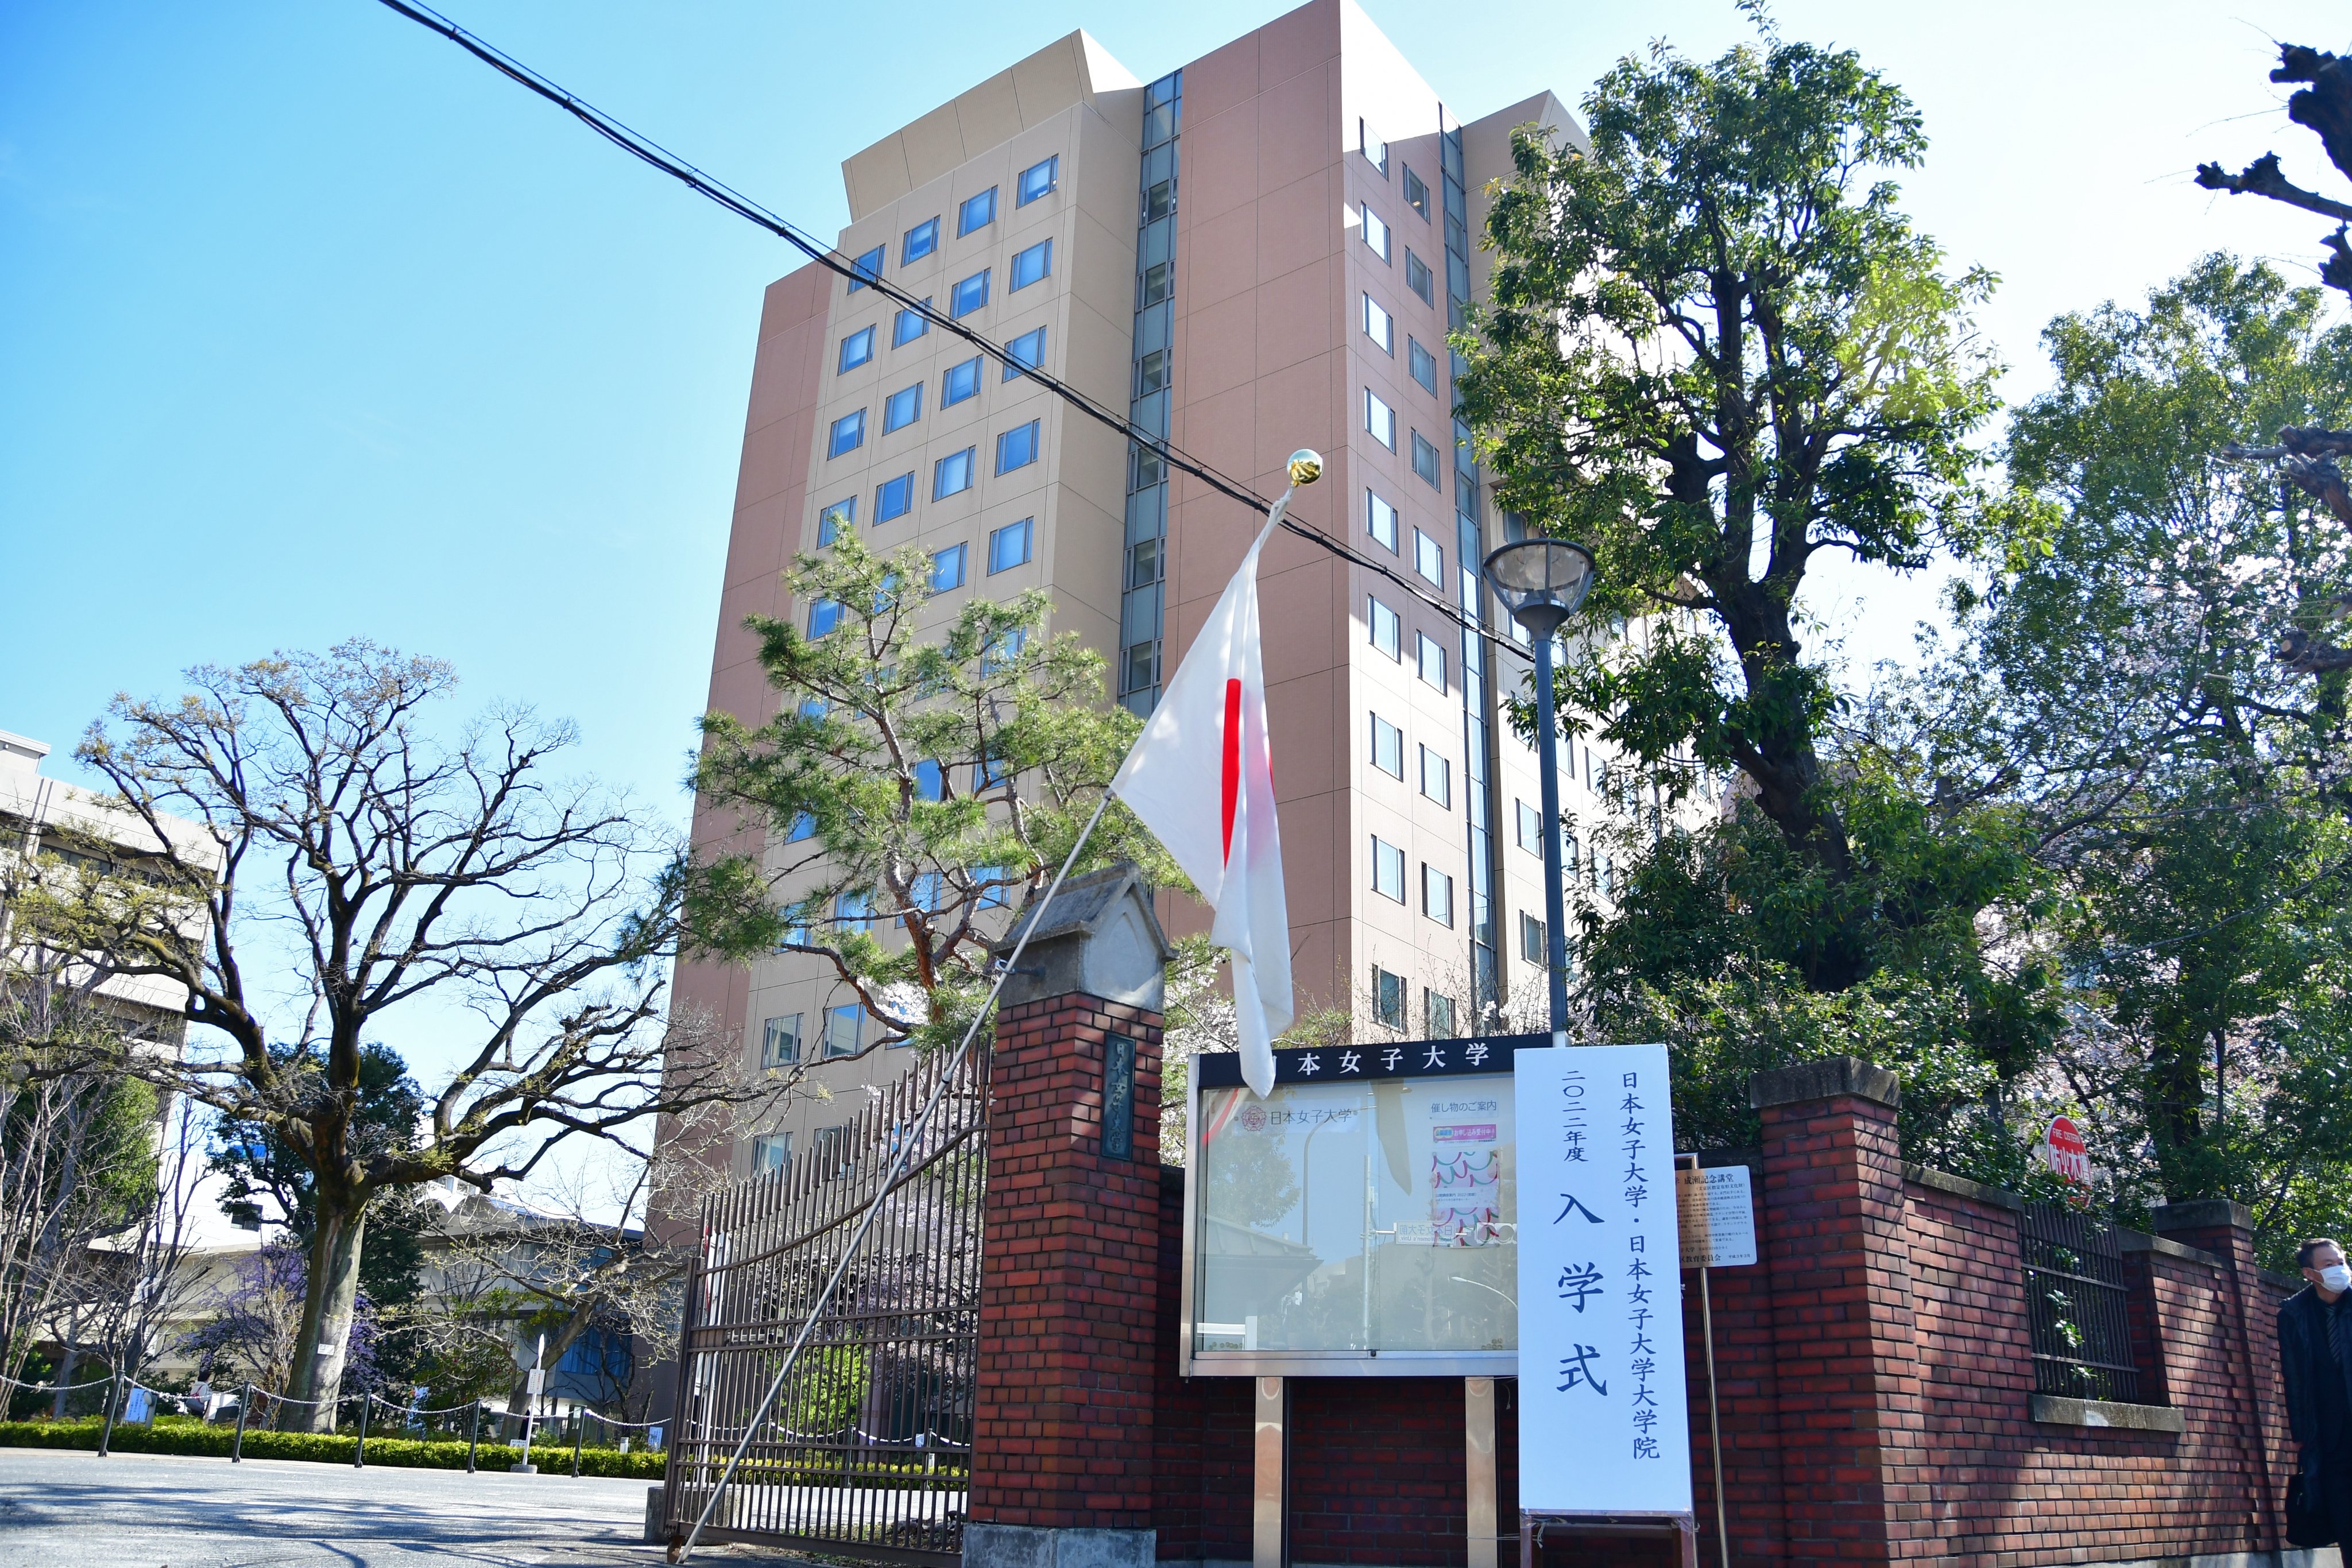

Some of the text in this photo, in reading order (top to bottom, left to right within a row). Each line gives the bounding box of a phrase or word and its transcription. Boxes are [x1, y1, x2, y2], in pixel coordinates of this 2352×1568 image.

[1272, 1043, 1489, 1075] 本女子大学
[1271, 1108, 1352, 1125] 日本女子大学
[1431, 1101, 1497, 1113] 催し物のご案内
[2052, 1128, 2063, 1139] FIRE
[1553, 1070, 1608, 1396] 二〇二二年度 入学式
[1619, 1072, 1661, 1460] 日本女子大学・日本女子大学大学院
